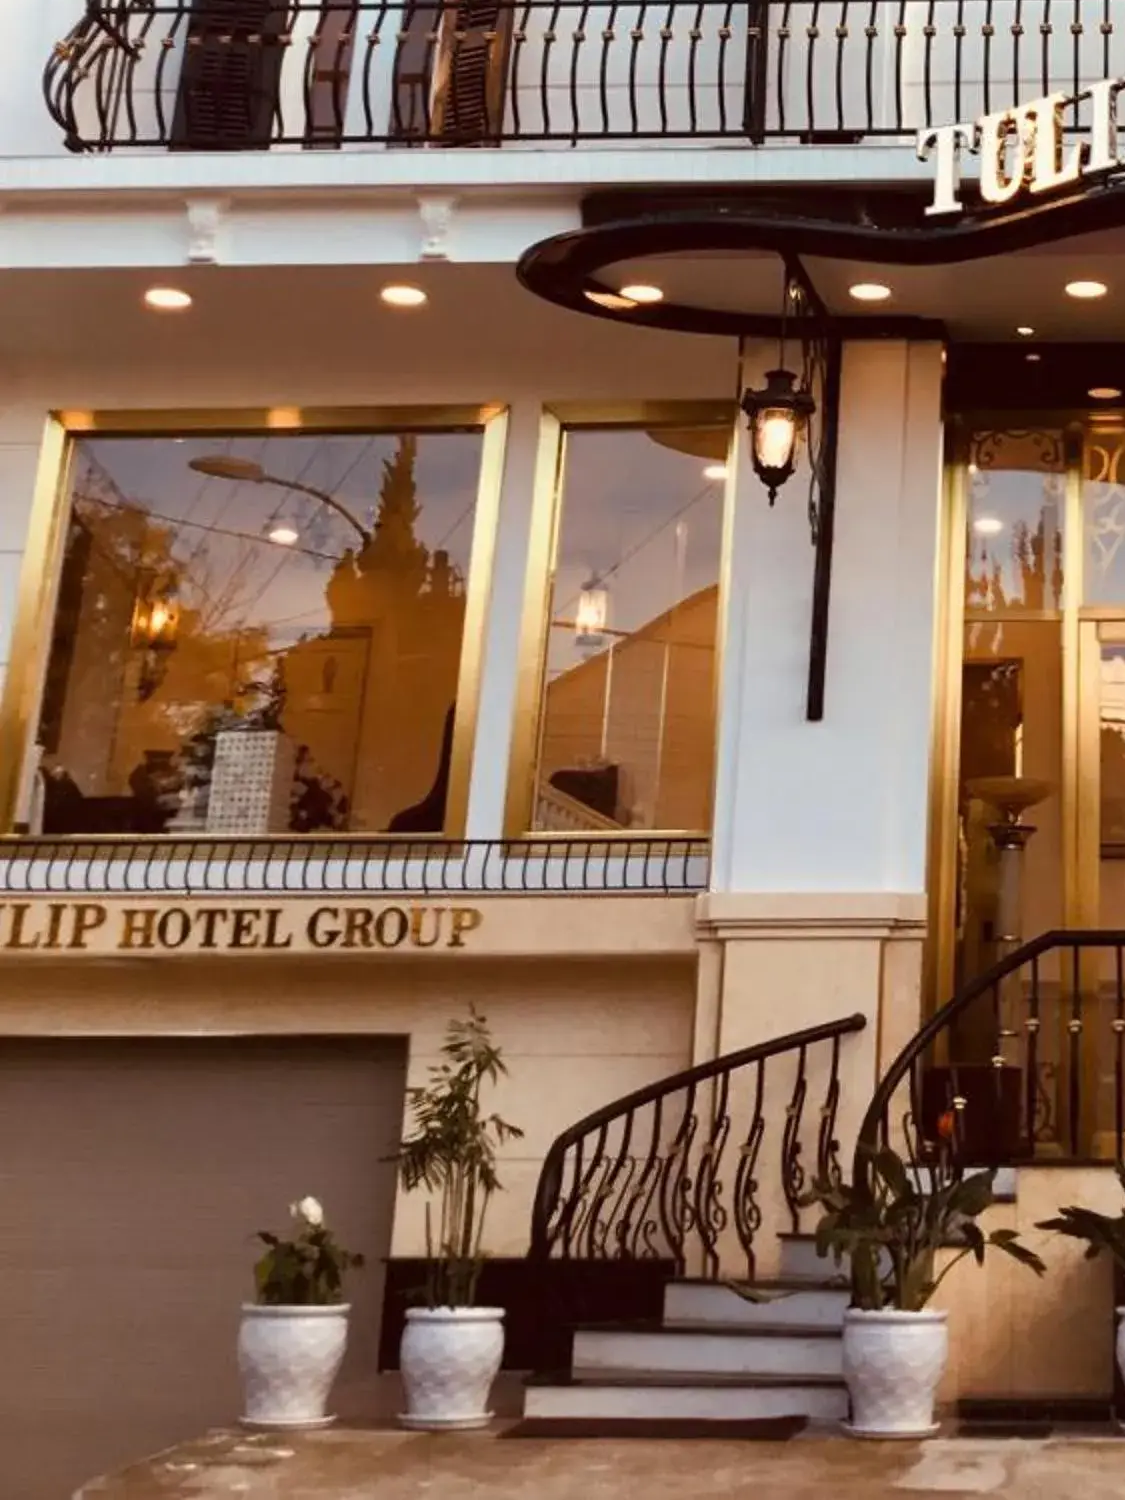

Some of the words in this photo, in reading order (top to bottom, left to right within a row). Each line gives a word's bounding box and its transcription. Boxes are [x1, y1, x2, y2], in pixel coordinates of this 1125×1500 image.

[0, 903, 108, 949] LIP
[117, 907, 293, 949] HOTEL
[306, 906, 484, 948] GROUP
